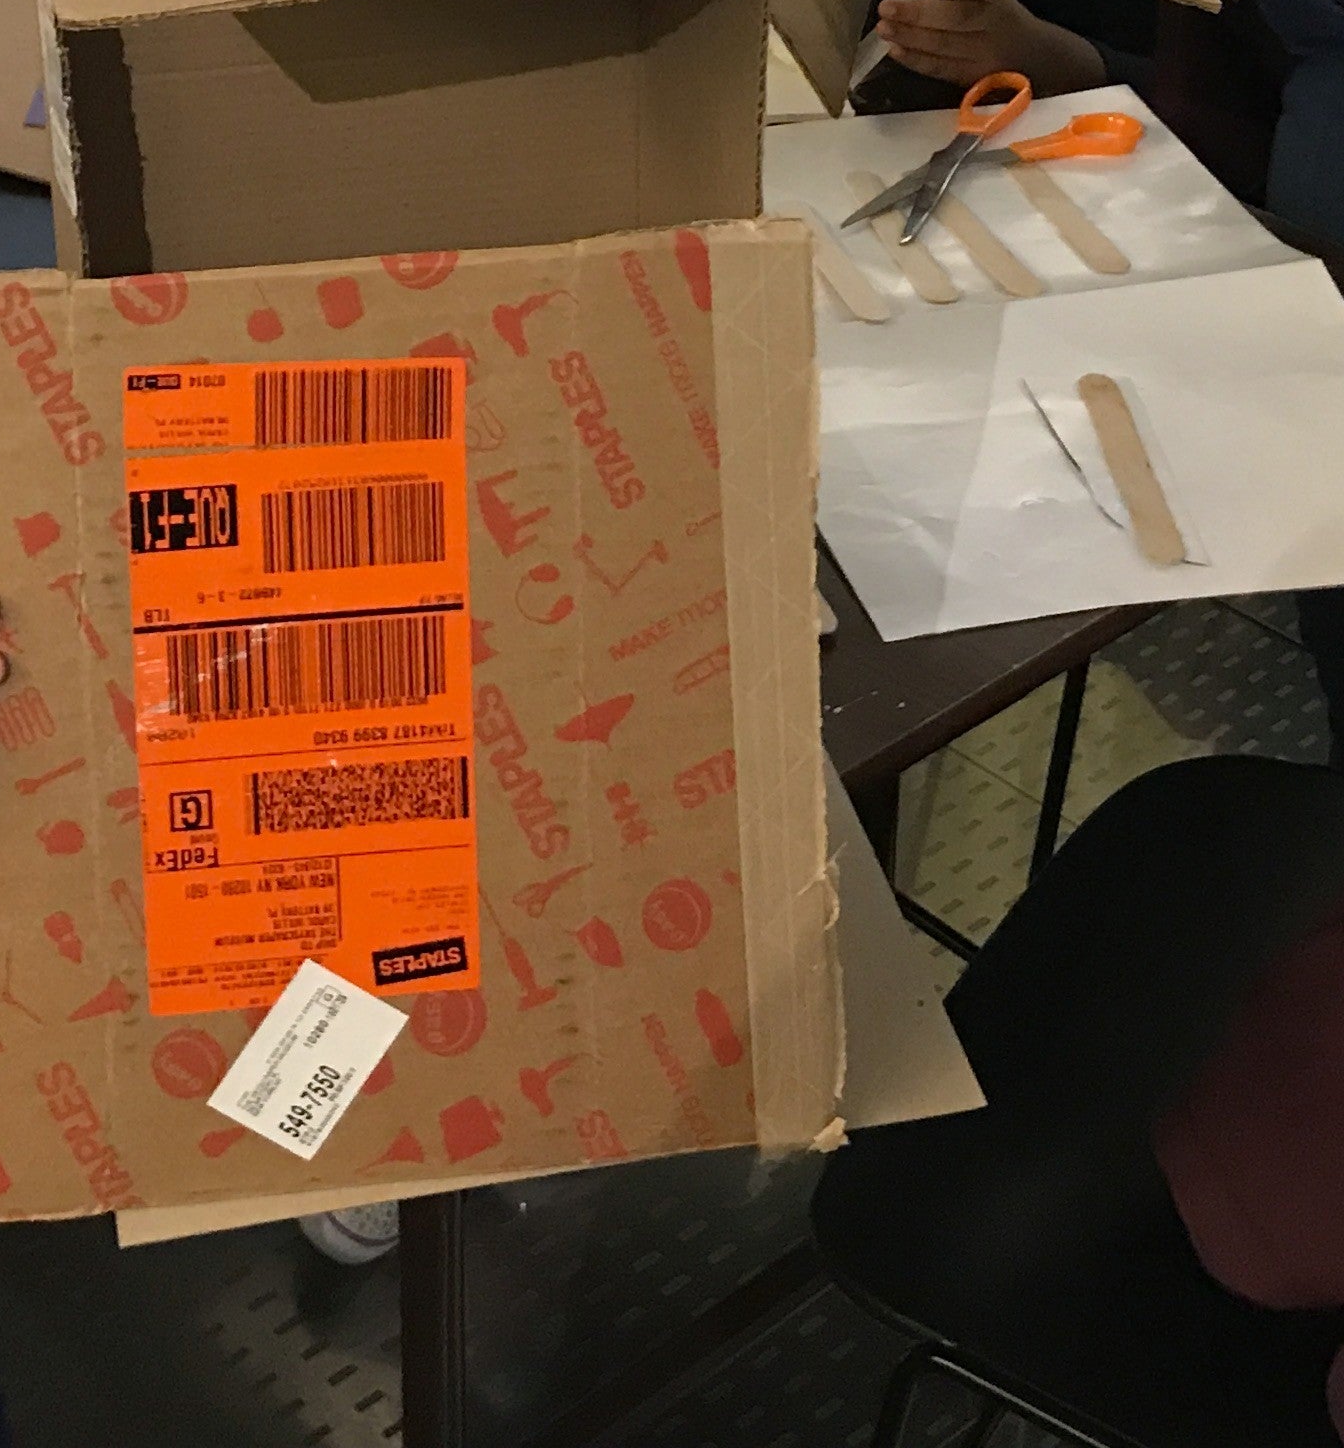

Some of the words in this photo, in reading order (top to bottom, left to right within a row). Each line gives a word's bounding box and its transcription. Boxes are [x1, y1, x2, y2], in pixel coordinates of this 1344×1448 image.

[547, 351, 645, 510] STAPLES
[138, 487, 231, 550] QUE-F1
[473, 683, 571, 861] STAPLES
[180, 795, 202, 827] G
[154, 846, 220, 872] FedEx
[378, 946, 462, 976] STAPLES
[36, 1059, 142, 1209] TAPLES
[278, 1065, 341, 1138] 549-7550
